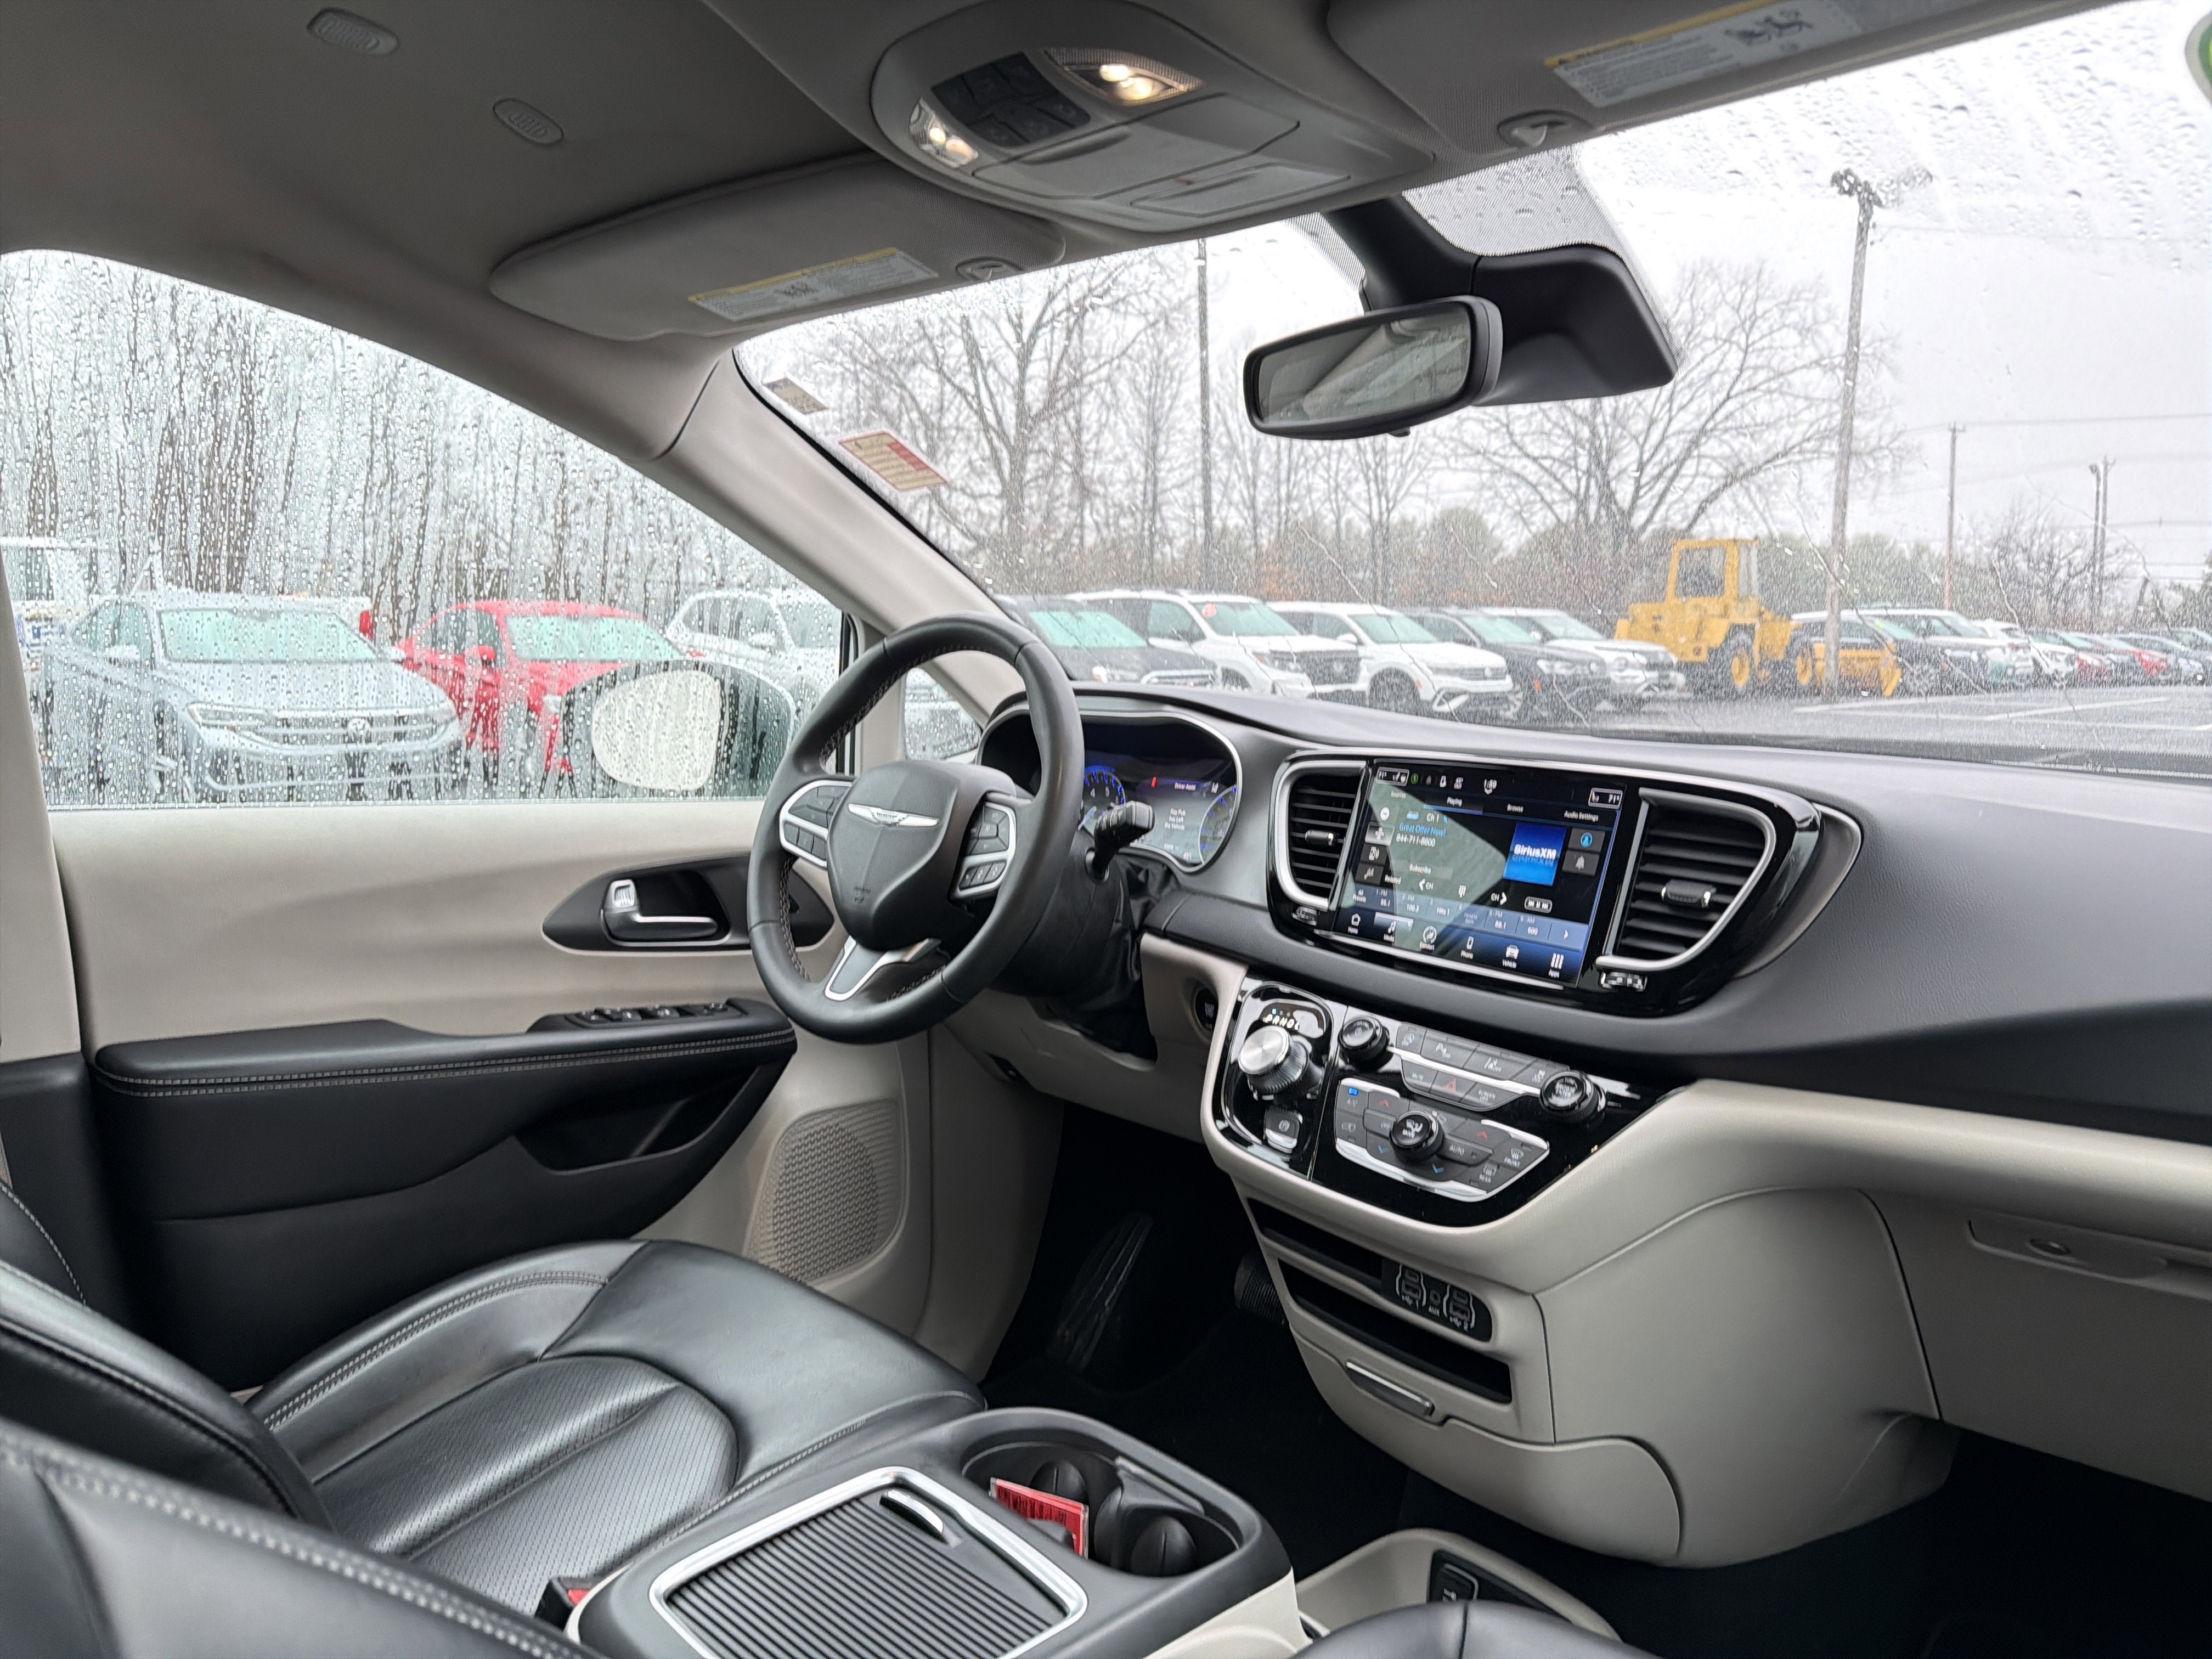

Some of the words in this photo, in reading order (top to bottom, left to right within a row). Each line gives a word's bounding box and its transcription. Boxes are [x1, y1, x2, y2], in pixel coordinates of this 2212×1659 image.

[1447, 797, 1463, 807] Playing
[1506, 803, 1524, 813] Browse
[1564, 810, 1578, 820] Audio
[1578, 811, 1599, 822] Settings
[1399, 822, 1414, 833] Great
[1415, 824, 1430, 834] Offer
[1430, 826, 1447, 837] Now!
[1409, 863, 1432, 875] Subscribe
[1425, 881, 1434, 890] CH
[1491, 892, 1500, 902] CH
[1548, 968, 1560, 979] Apps
[1449, 1144, 1465, 1155] AUTO
[1428, 1305, 1440, 1317] AUX
